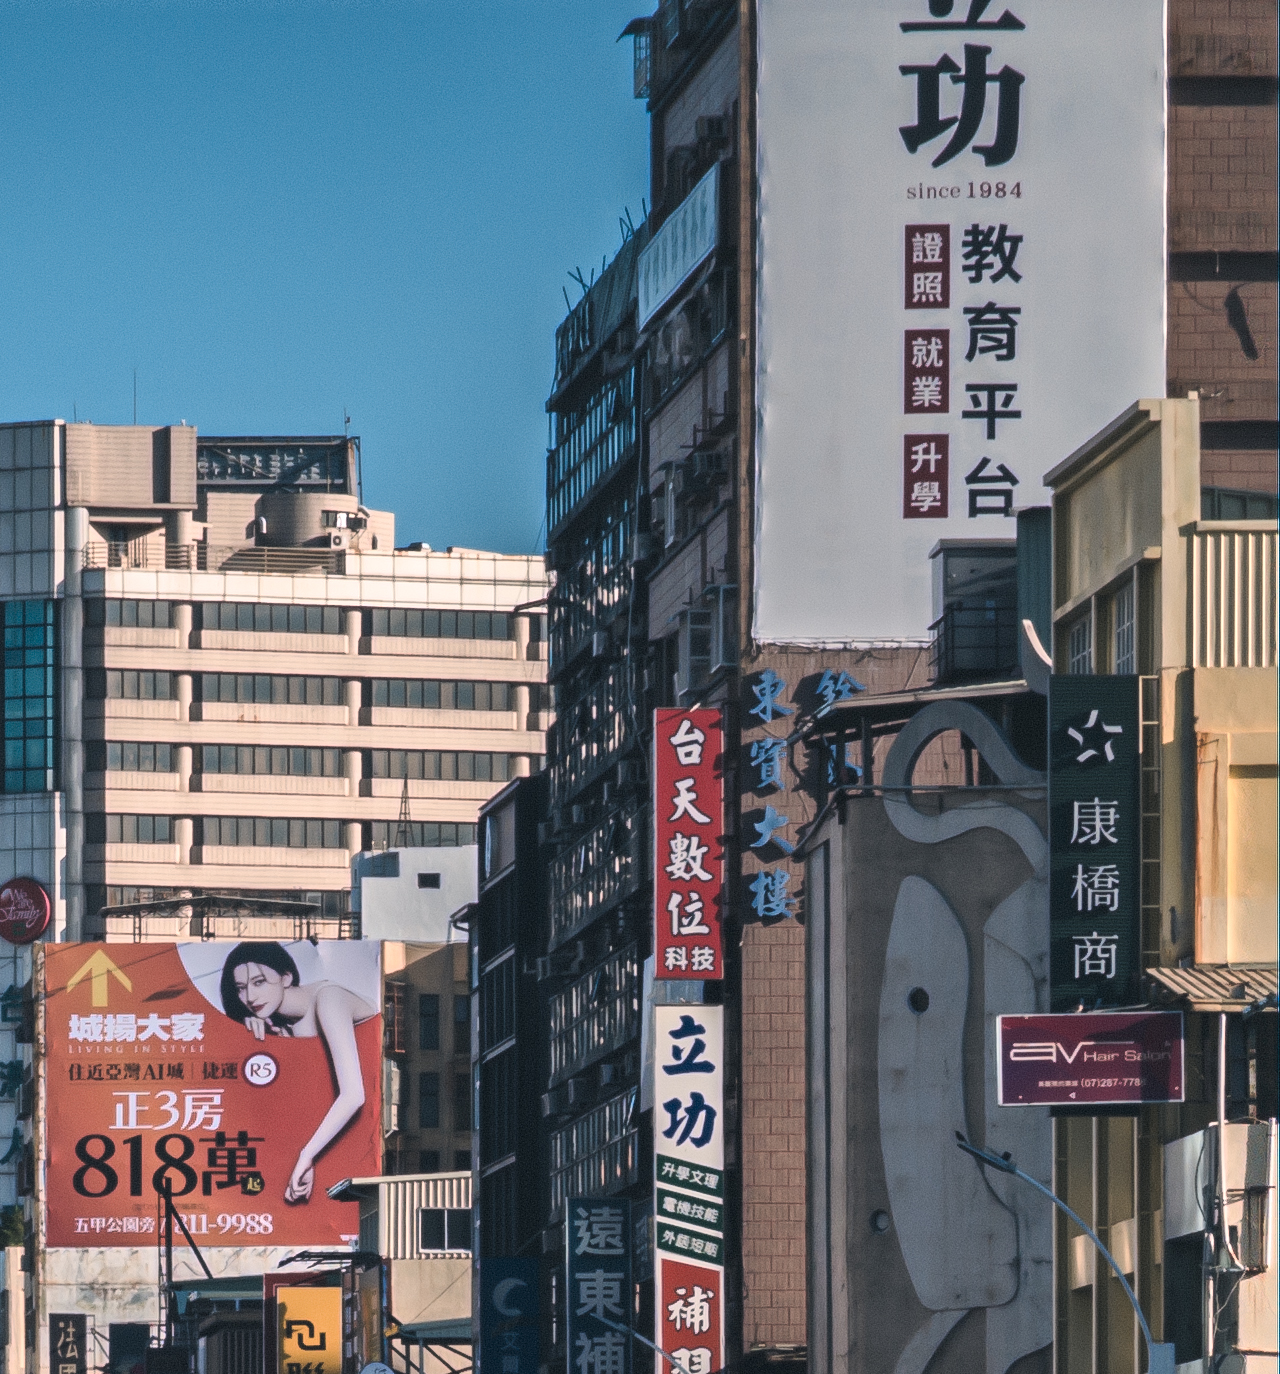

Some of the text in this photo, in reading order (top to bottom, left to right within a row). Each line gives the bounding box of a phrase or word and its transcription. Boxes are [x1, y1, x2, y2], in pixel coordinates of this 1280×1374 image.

[907, 182, 1023, 199] since 1984
[912, 232, 943, 302] 證照
[912, 337, 943, 406] 就業
[961, 223, 1024, 518] 教育平台
[911, 443, 942, 511] 升學
[665, 719, 714, 937] 台天數位
[1070, 797, 1120, 979] 康橋商
[665, 946, 715, 972] 科技
[68, 1013, 205, 1042] 城揚大家
[68, 1044, 125, 1054] LIVING
[249, 1062, 273, 1078] R5
[662, 1014, 718, 1150] 立功
[1084, 1051, 1120, 1063] Hair
[108, 1089, 225, 1131] 正3房
[72, 1131, 265, 1197] 818萬
[661, 1161, 720, 1190] 升學文理
